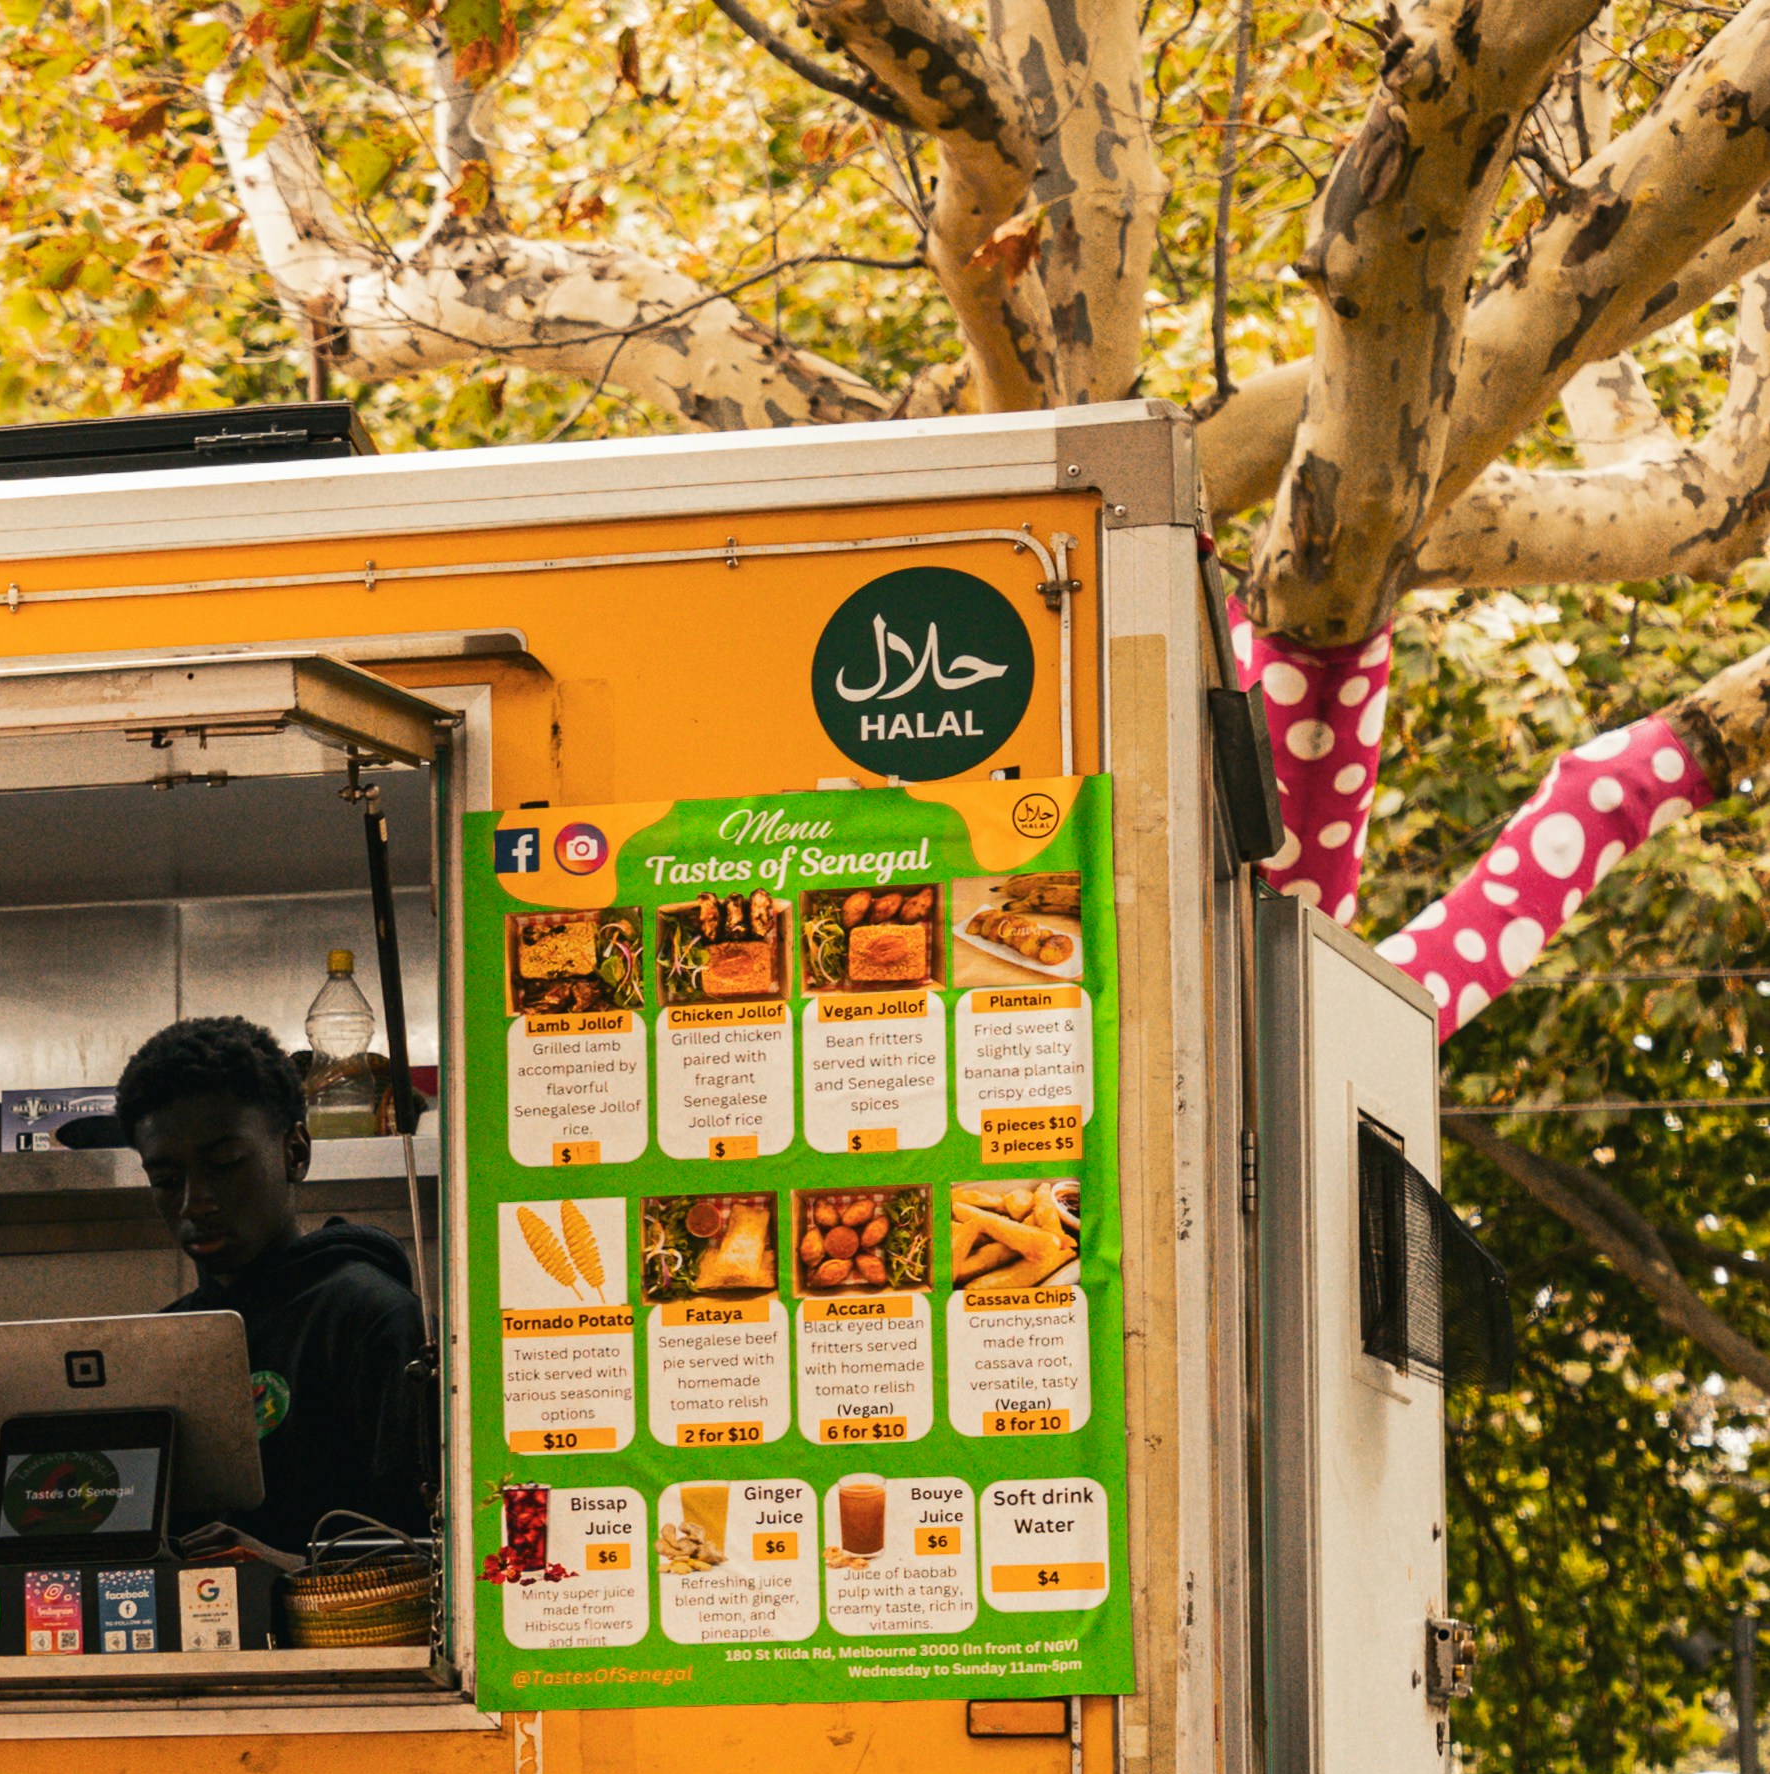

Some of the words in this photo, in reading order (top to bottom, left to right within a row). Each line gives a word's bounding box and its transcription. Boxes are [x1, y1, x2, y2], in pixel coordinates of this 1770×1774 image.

[835, 612, 1009, 703] حلال
[859, 709, 985, 742] HALAL
[718, 808, 834, 846] Menu
[1021, 822, 1051, 830] HALAL
[645, 854, 751, 885] Tastes
[755, 845, 797, 891] of
[799, 838, 932, 885] Senegal
[989, 992, 1053, 1009] Plantain
[669, 1008, 734, 1024] Chicken
[736, 1003, 784, 1020] Jollof
[822, 1004, 874, 1022] Vegan
[876, 998, 927, 1017] Jollof
[526, 1018, 571, 1035] Lamb
[577, 1015, 624, 1032] Jollof
[532, 1041, 581, 1056] Grilled
[584, 1039, 622, 1053] lamb
[825, 1035, 864, 1049] Bean
[868, 1032, 923, 1046] fritters
[517, 1059, 615, 1077] accompanied
[618, 1059, 637, 1075] by
[812, 1055, 866, 1071] served
[869, 1053, 903, 1068] with
[907, 1054, 937, 1066] rice
[545, 1080, 609, 1096] flavorful
[814, 1077, 844, 1093] and
[847, 1074, 935, 1092] Senegalese
[513, 1102, 597, 1120] Senegalese
[599, 1098, 642, 1114] Jollof
[850, 1097, 900, 1114] spices
[562, 1123, 594, 1136] rice.
[982, 1119, 994, 1134] 6
[996, 1118, 1046, 1136] pieces
[1048, 1115, 1078, 1131] $10
[990, 1140, 1000, 1154] 3
[1002, 1138, 1053, 1156] pieces
[1054, 1136, 1075, 1151] $5
[964, 1293, 1031, 1308] Cassava
[1033, 1289, 1078, 1307] Chips
[685, 1308, 744, 1325] Fataya
[825, 1302, 887, 1317] Accara
[502, 1314, 575, 1332] Tornado
[577, 1312, 635, 1330] Potato
[658, 1334, 742, 1351] Senegalese
[744, 1330, 778, 1345] beef
[982, 1335, 1025, 1349] made
[1028, 1333, 1064, 1348] from
[662, 1358, 686, 1373] pie
[688, 1353, 739, 1369] served
[742, 1352, 775, 1366] with
[677, 1374, 761, 1390] homemade
[969, 1376, 1038, 1392] versatile,
[1041, 1376, 1079, 1390] tasty
[669, 1398, 725, 1411] tomato
[728, 1395, 769, 1409] relish
[836, 1401, 895, 1420] (Vegan)
[994, 1396, 1052, 1415] (Vegan)
[826, 1425, 839, 1441] 6
[842, 1424, 869, 1440] for
[871, 1422, 906, 1440] $10
[994, 1417, 1007, 1433] 8
[1009, 1416, 1037, 1432] for
[1039, 1415, 1062, 1431] 10
[542, 1431, 578, 1451] $10
[684, 1428, 695, 1444] 2
[697, 1427, 725, 1443] for
[727, 1426, 761, 1444] $10
[24, 1488, 63, 1501] Tastes
[67, 1487, 82, 1499] Of
[86, 1485, 135, 1500] Senegal
[743, 1485, 804, 1505] Ginger
[910, 1486, 964, 1504] Bouye
[992, 1488, 1037, 1507] Soft
[1041, 1486, 1095, 1506] drink
[570, 1496, 628, 1514] Bissap
[754, 1509, 804, 1526] Juice
[918, 1508, 964, 1525] Juice
[584, 1519, 633, 1537] Juice
[1013, 1517, 1076, 1535] Water
[765, 1539, 786, 1555] $6
[927, 1533, 949, 1550] $6
[597, 1549, 618, 1565] $6
[1037, 1568, 1061, 1588] $4
[105, 1590, 150, 1601] facebook
[725, 1649, 751, 1661] 180
[755, 1649, 770, 1661] St
[774, 1648, 810, 1661] Kilda
[812, 1647, 835, 1661] Rd,
[838, 1645, 917, 1659] Melbourne
[920, 1644, 959, 1657] 3000
[963, 1642, 981, 1657] (In
[984, 1642, 1024, 1655] front
[1027, 1642, 1042, 1654] of
[1044, 1640, 1079, 1654] NGV)
[512, 1666, 693, 1689] @TastesOfSenegal
[848, 1664, 930, 1680] Wednesday
[933, 1664, 949, 1676] to
[952, 1662, 1006, 1678] Sunday
[1010, 1659, 1083, 1676] 11am-5pm
